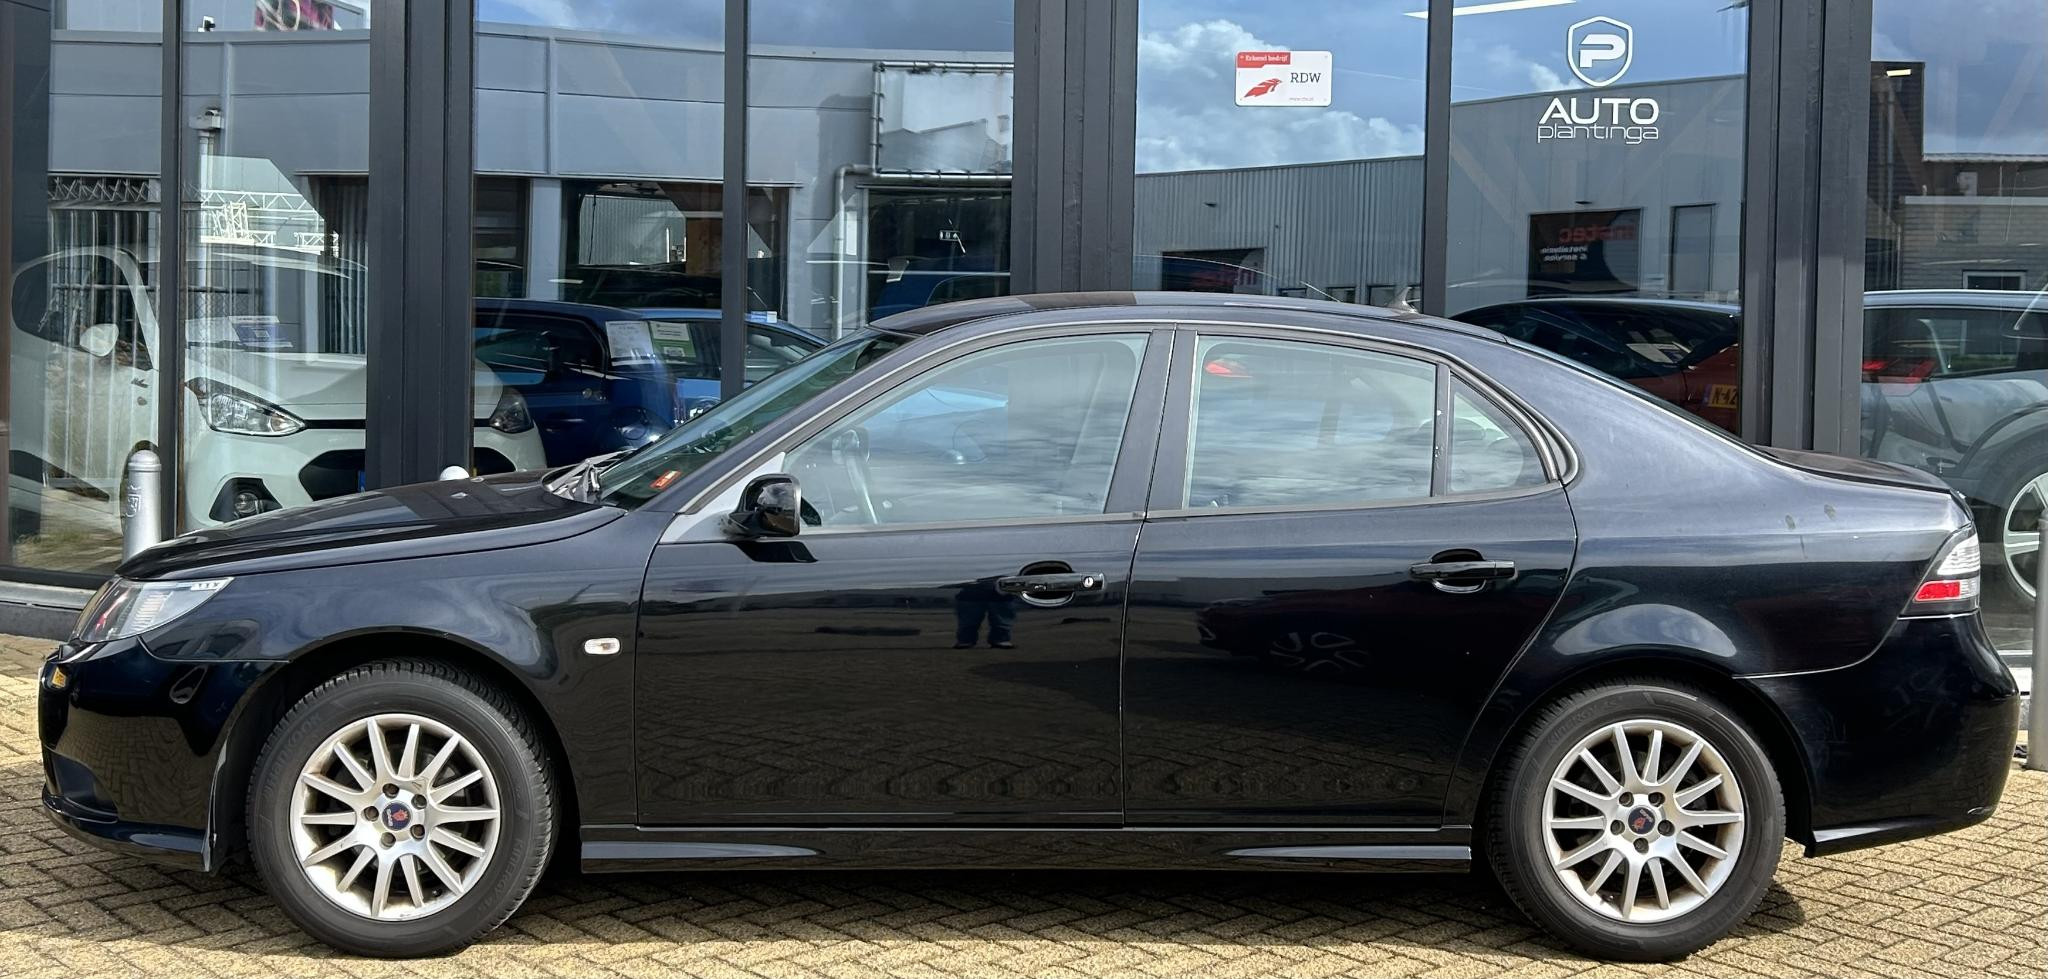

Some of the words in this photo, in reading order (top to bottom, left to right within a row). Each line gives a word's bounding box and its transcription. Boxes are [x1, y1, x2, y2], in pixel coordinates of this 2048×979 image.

[1579, 33, 1626, 68] P
[1290, 72, 1321, 83] RDW
[1538, 97, 1660, 125] AUTO
[1537, 123, 1659, 144] plantinga
